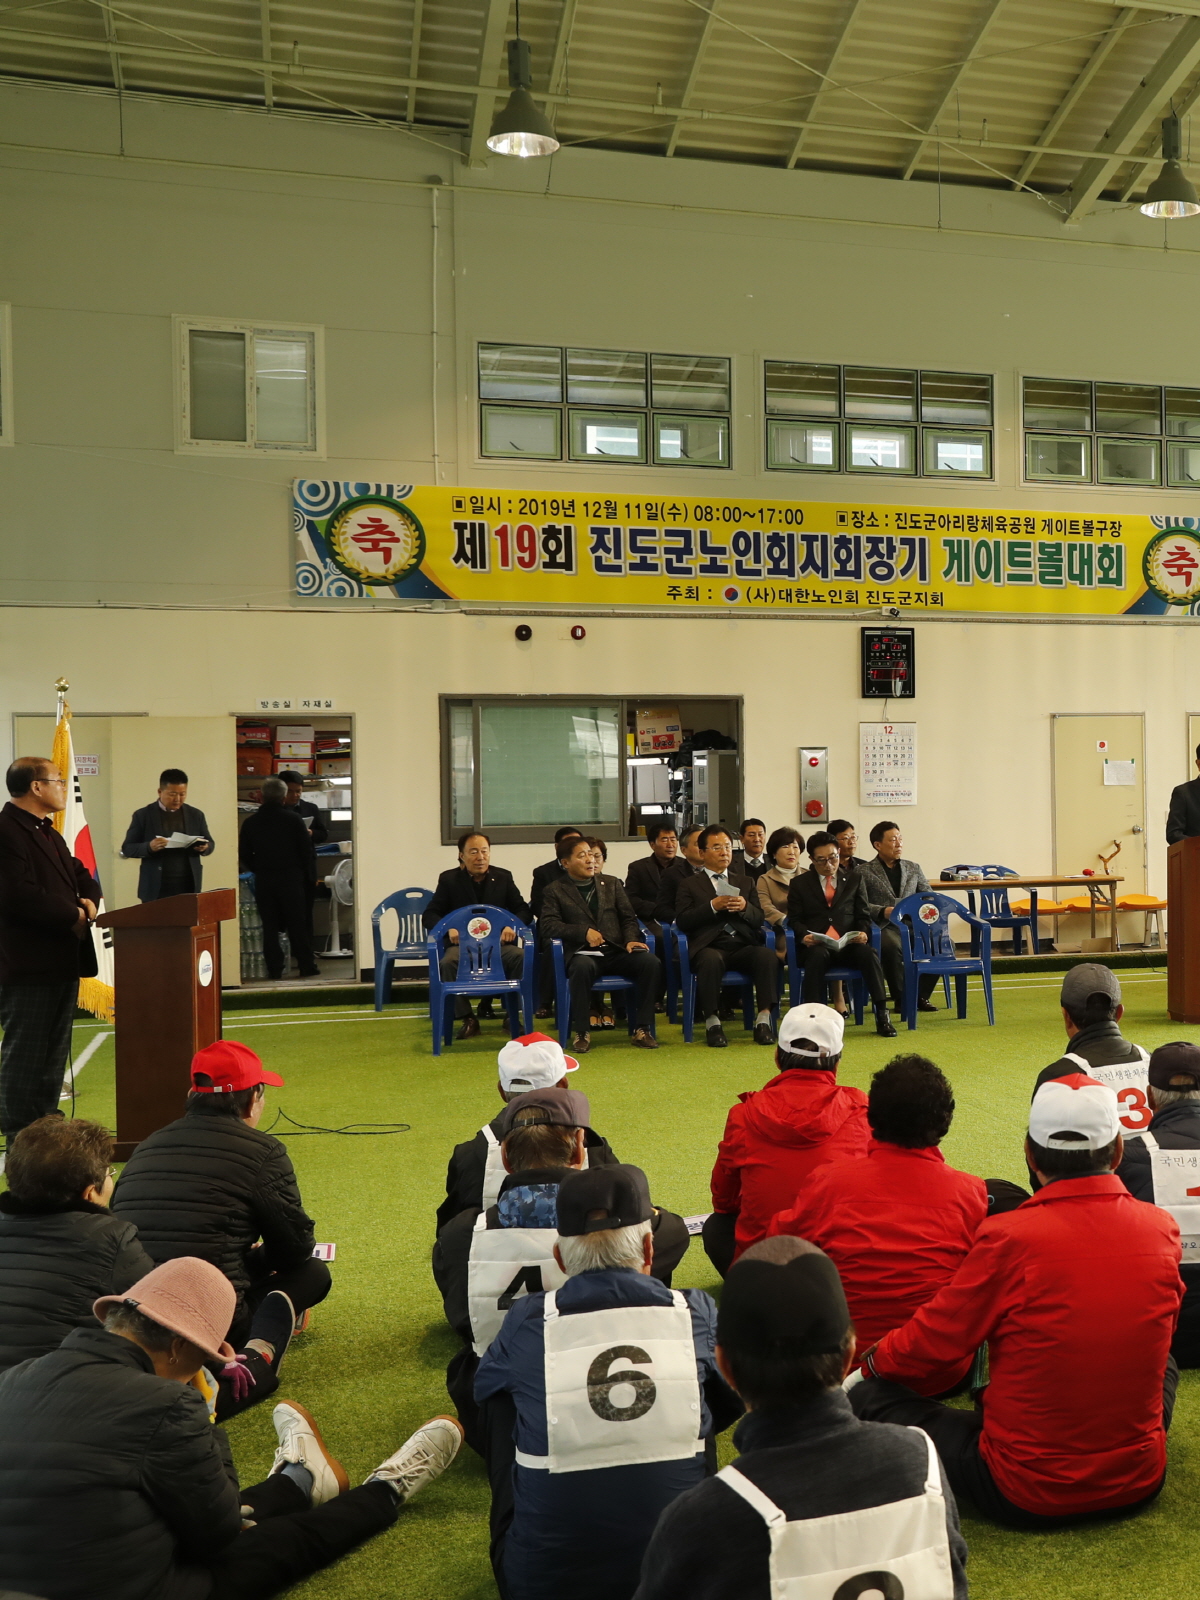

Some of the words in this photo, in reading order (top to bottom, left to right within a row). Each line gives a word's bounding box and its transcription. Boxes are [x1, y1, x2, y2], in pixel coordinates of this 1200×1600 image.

[469, 496, 501, 515] 일시
[518, 498, 576, 518] 2019년
[583, 500, 618, 520] 12월
[625, 502, 688, 523] 11일(수)
[694, 505, 804, 526] 08:00~17:00
[851, 510, 880, 529] 장소
[894, 512, 1036, 535] 진도군아리랑체육공원
[1041, 518, 1122, 538] 게이트볼구장
[351, 516, 401, 565] 축
[452, 521, 573, 571] 제19회
[589, 526, 927, 583] 진도군노인회지회장기
[942, 538, 1124, 587] 게이트볼대회
[1161, 545, 1199, 587] 축
[666, 585, 700, 601] 주최
[746, 586, 859, 604] (사)대한노인회
[866, 590, 944, 607] 진도군지회
[260, 700, 291, 708] 방송실
[302, 700, 332, 708] 자재실
[884, 726, 893, 734] 12
[1117, 1087, 1154, 1130] 3
[586, 1345, 657, 1422] 6
